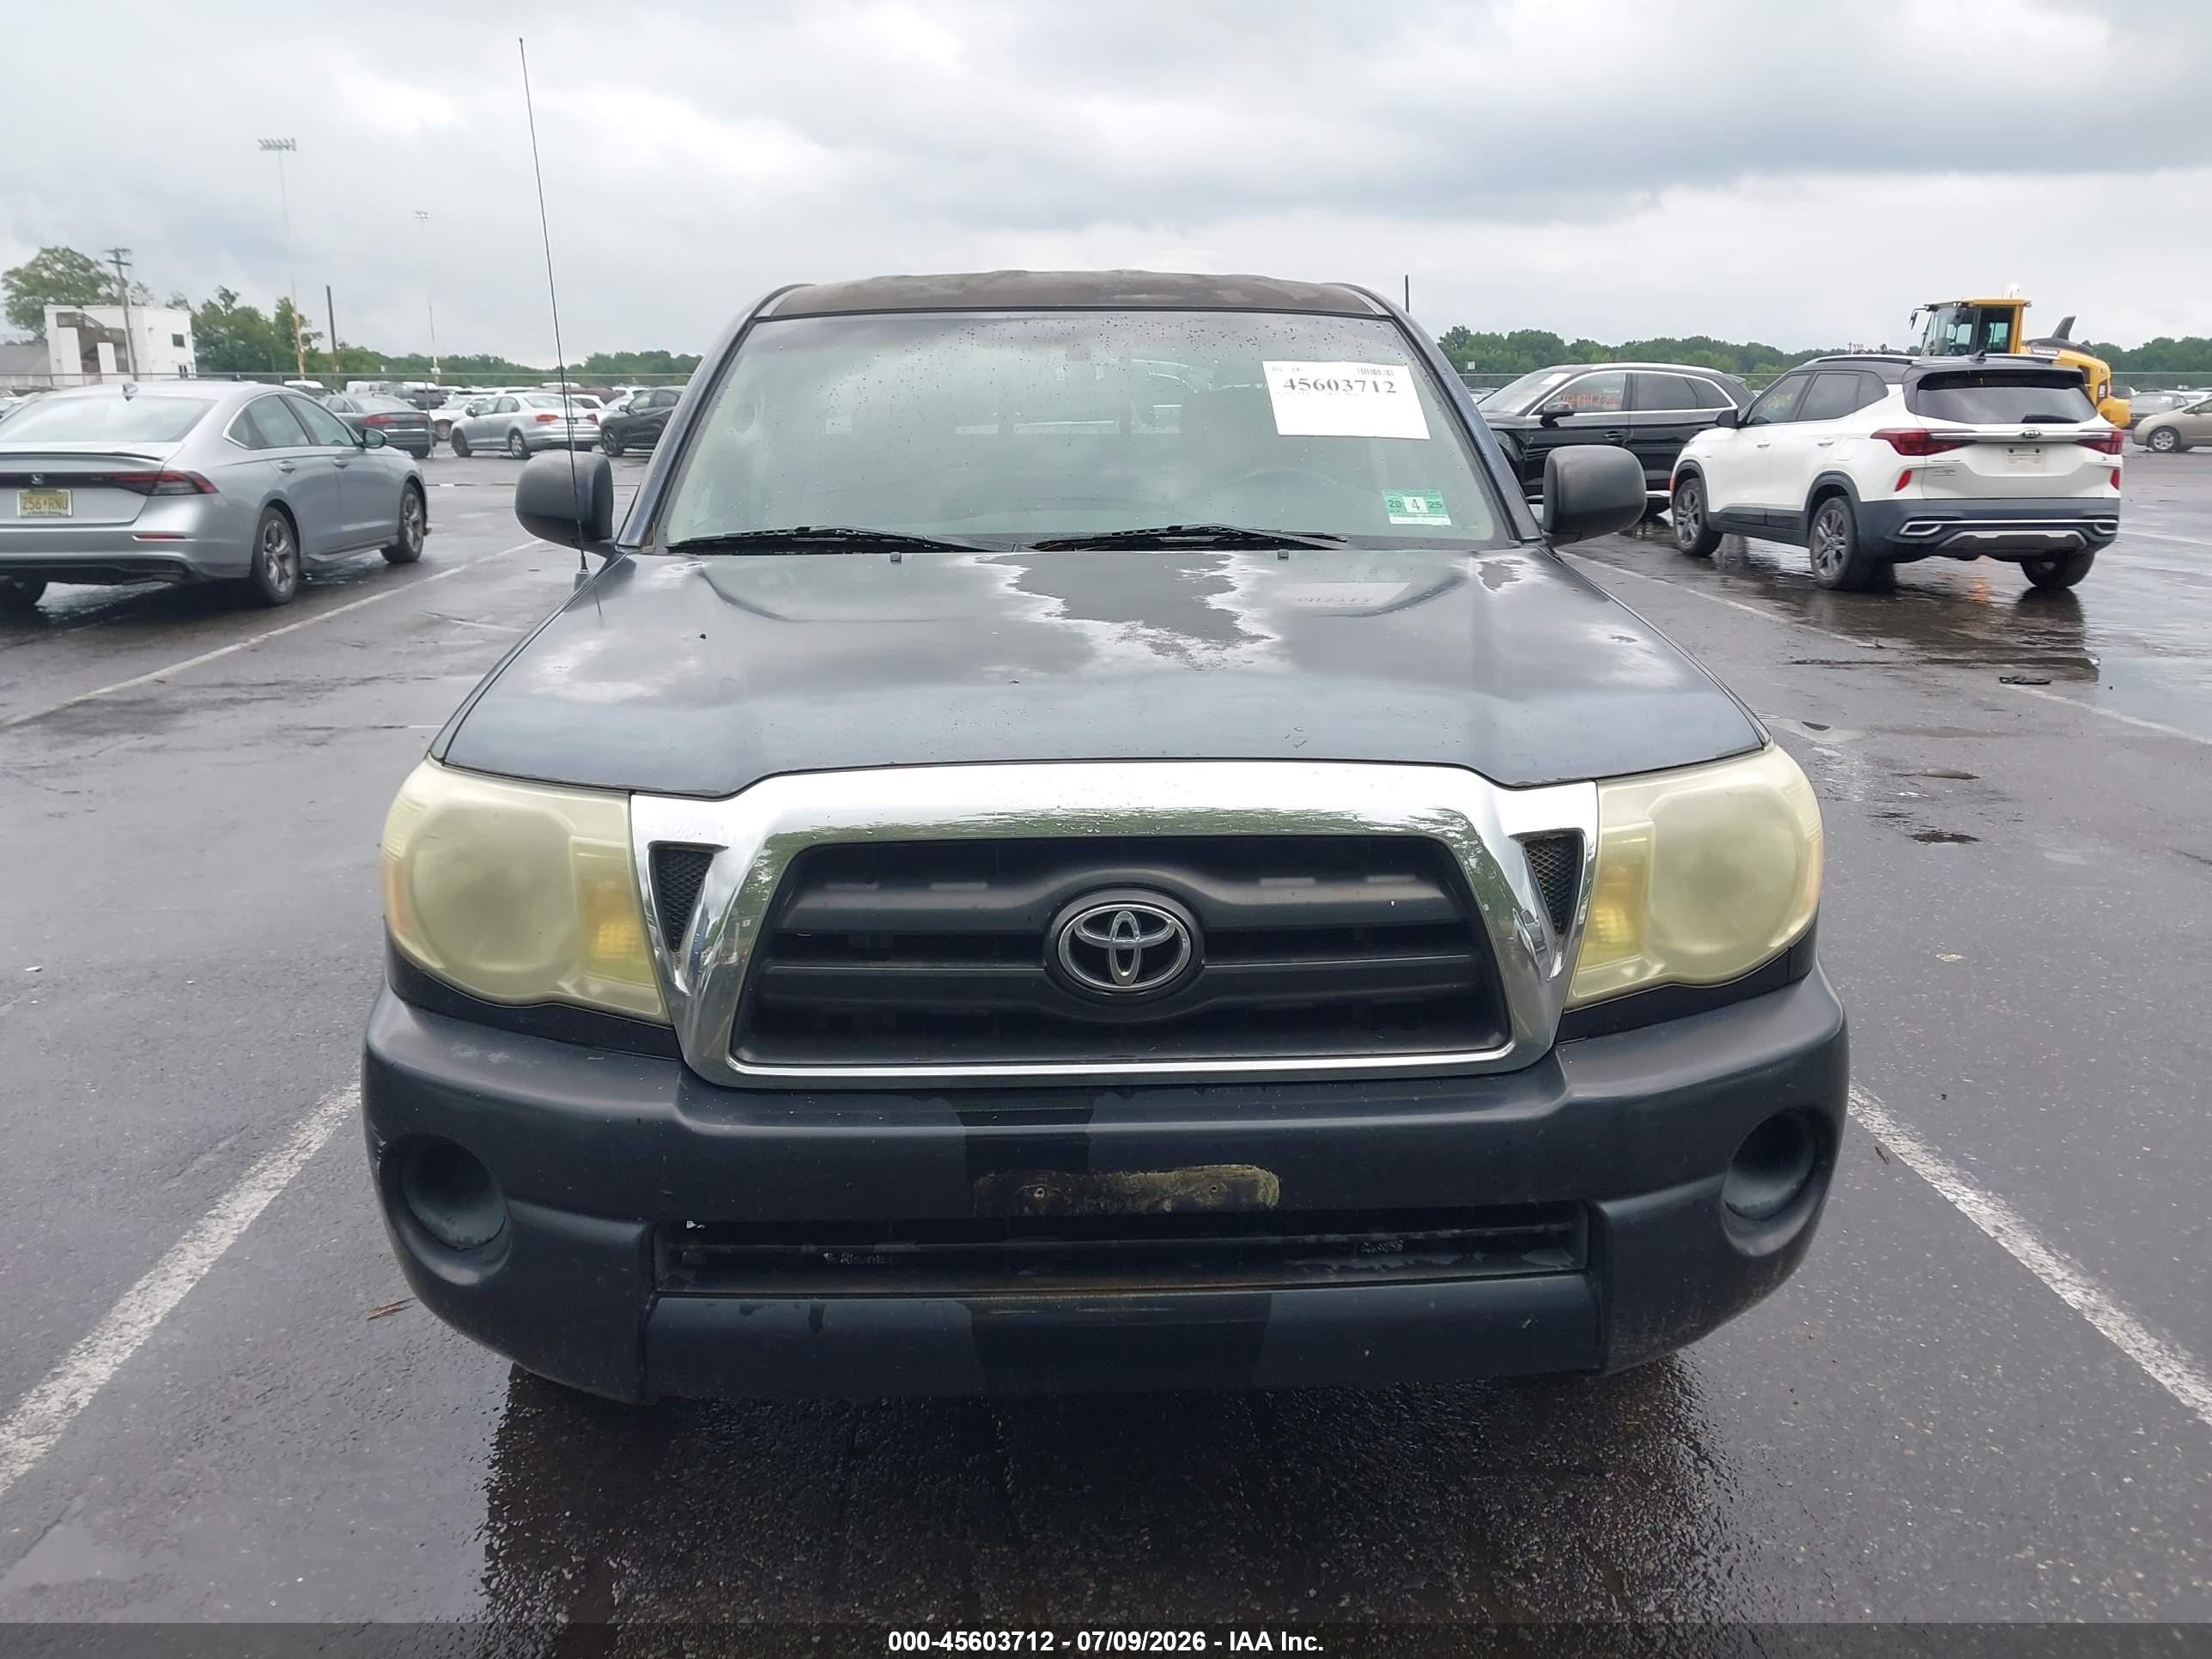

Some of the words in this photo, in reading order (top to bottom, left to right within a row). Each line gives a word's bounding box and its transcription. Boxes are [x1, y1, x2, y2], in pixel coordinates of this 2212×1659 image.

[1283, 378, 1397, 393] 45603712
[1388, 500, 1402, 508] 20
[1412, 499, 1421, 511] 4
[1427, 501, 1443, 509] 25
